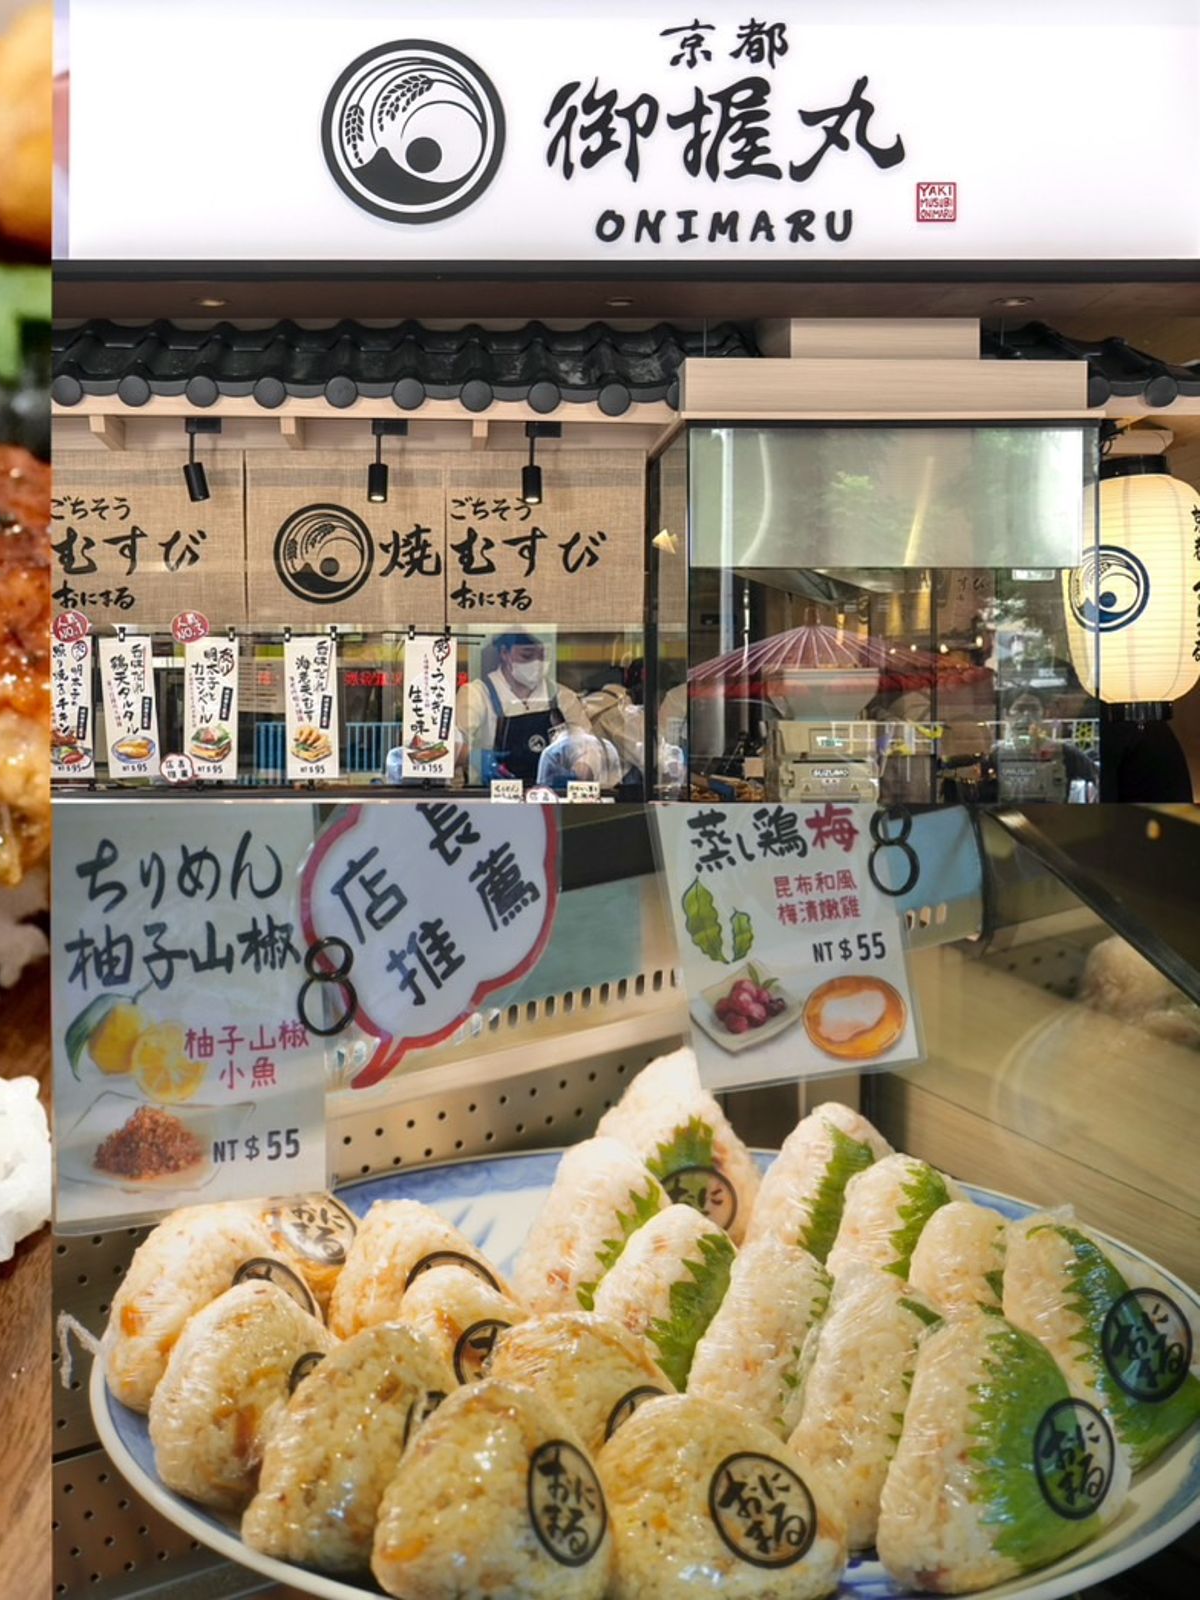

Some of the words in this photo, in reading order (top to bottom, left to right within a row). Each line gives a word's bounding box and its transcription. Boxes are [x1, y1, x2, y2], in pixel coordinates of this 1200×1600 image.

[659, 18, 790, 69] 京都
[544, 76, 906, 182] 御握丸
[920, 183, 952, 197] YAKI
[595, 208, 854, 243] ONIMARU
[50, 496, 131, 521] ごちそう
[450, 497, 532, 521] ごちそう
[50, 525, 208, 576] むすび
[51, 580, 136, 610] おにまる
[450, 580, 533, 611] おにまる
[76, 830, 283, 908] ちりめん
[773, 869, 858, 898] 昆布和風
[64, 914, 304, 991] 柚子山椒
[184, 1019, 310, 1060] 柚子山椒
[219, 1058, 278, 1089] 小魚
[717, 1467, 791, 1520] おに
